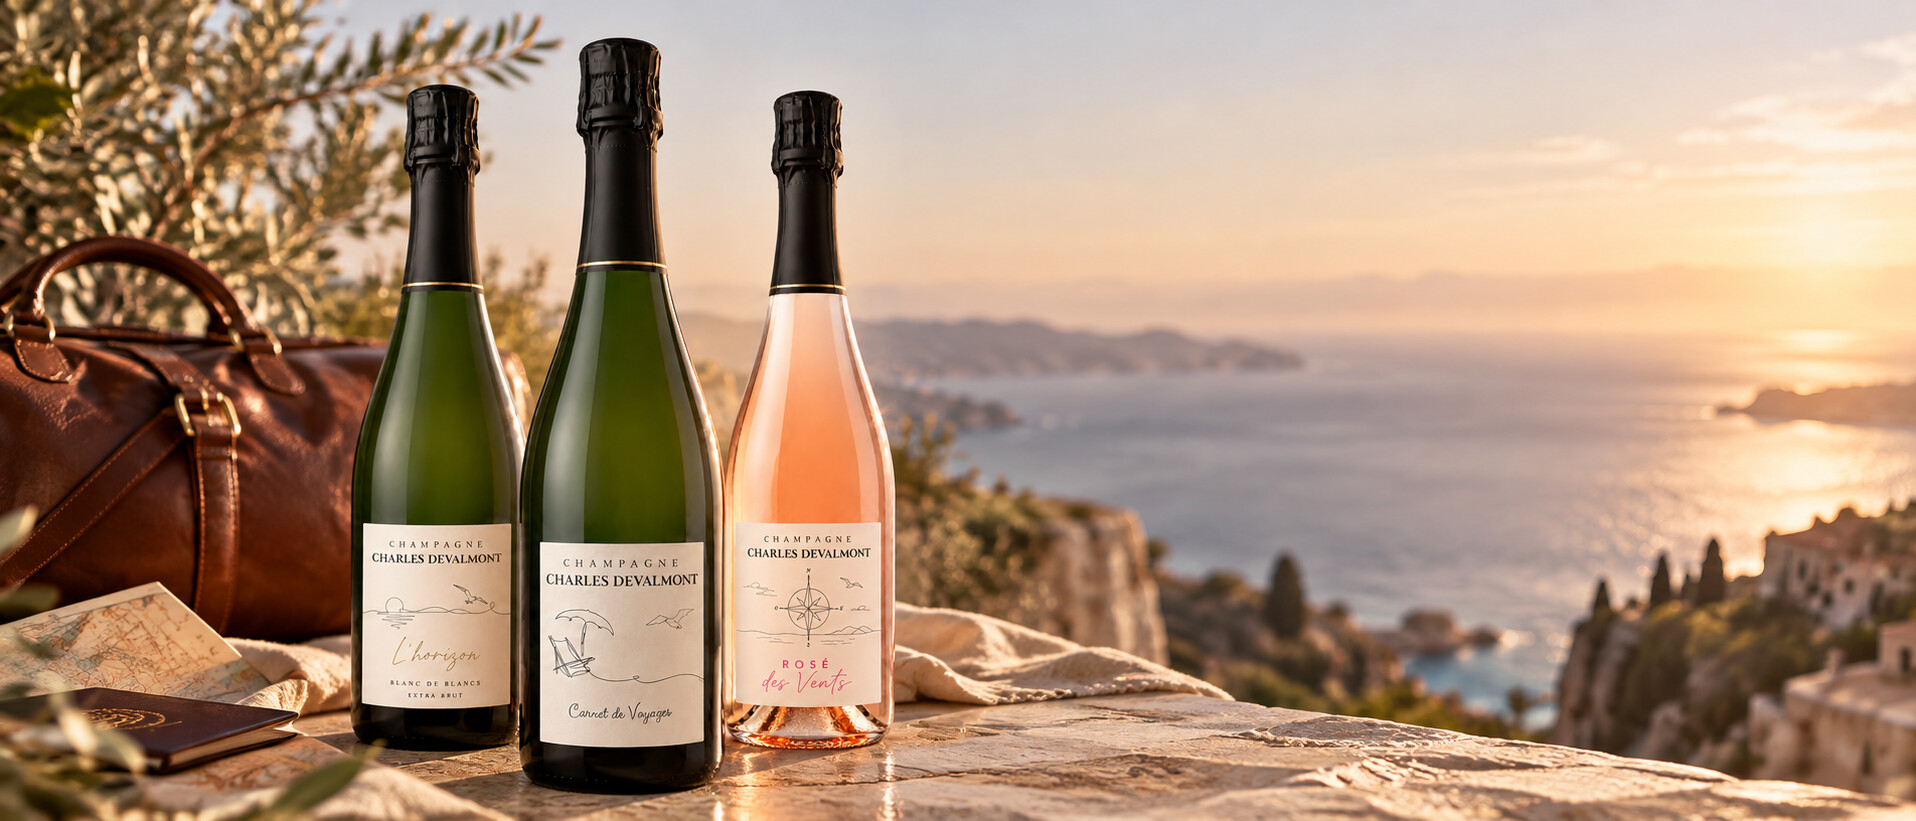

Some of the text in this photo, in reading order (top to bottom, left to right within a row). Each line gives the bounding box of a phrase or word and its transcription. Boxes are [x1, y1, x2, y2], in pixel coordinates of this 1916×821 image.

[764, 535, 852, 543] CHAMPAGNE
[372, 553, 502, 564] CHARLES DEVALMONT
[747, 548, 871, 559] CHARLES DEVALMONT
[563, 559, 679, 568] CHAMPAGNE
[546, 573, 698, 587] CHARLES DEVALMONT
[392, 636, 480, 672] L'horizon
[782, 658, 829, 669] ROSÉ
[762, 669, 852, 695] des Vents
[611, 707, 625, 719] de
[628, 702, 672, 724] Voyages
